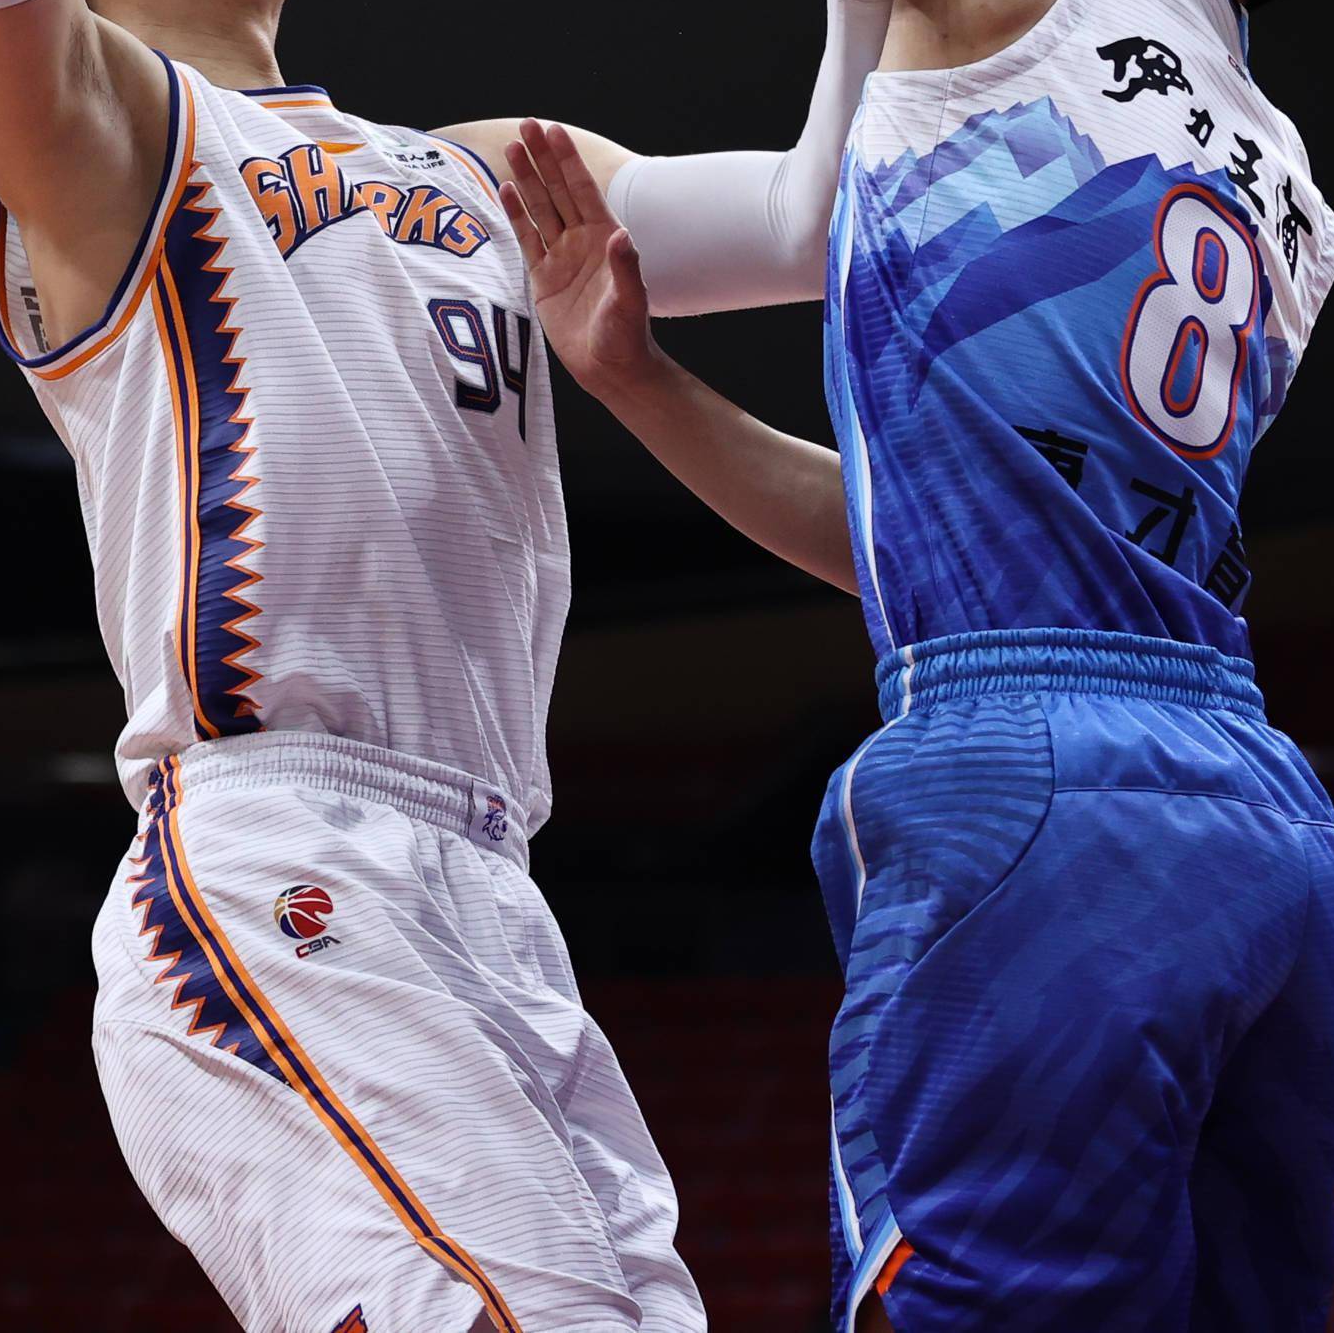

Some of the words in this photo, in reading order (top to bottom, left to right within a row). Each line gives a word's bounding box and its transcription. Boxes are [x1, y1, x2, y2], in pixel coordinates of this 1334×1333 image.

[239, 143, 491, 261] SHRKS
[421, 160, 446, 170] LIFE
[427, 298, 531, 443] 94
[1120, 182, 1260, 460] 8
[295, 935, 341, 959] CBA
